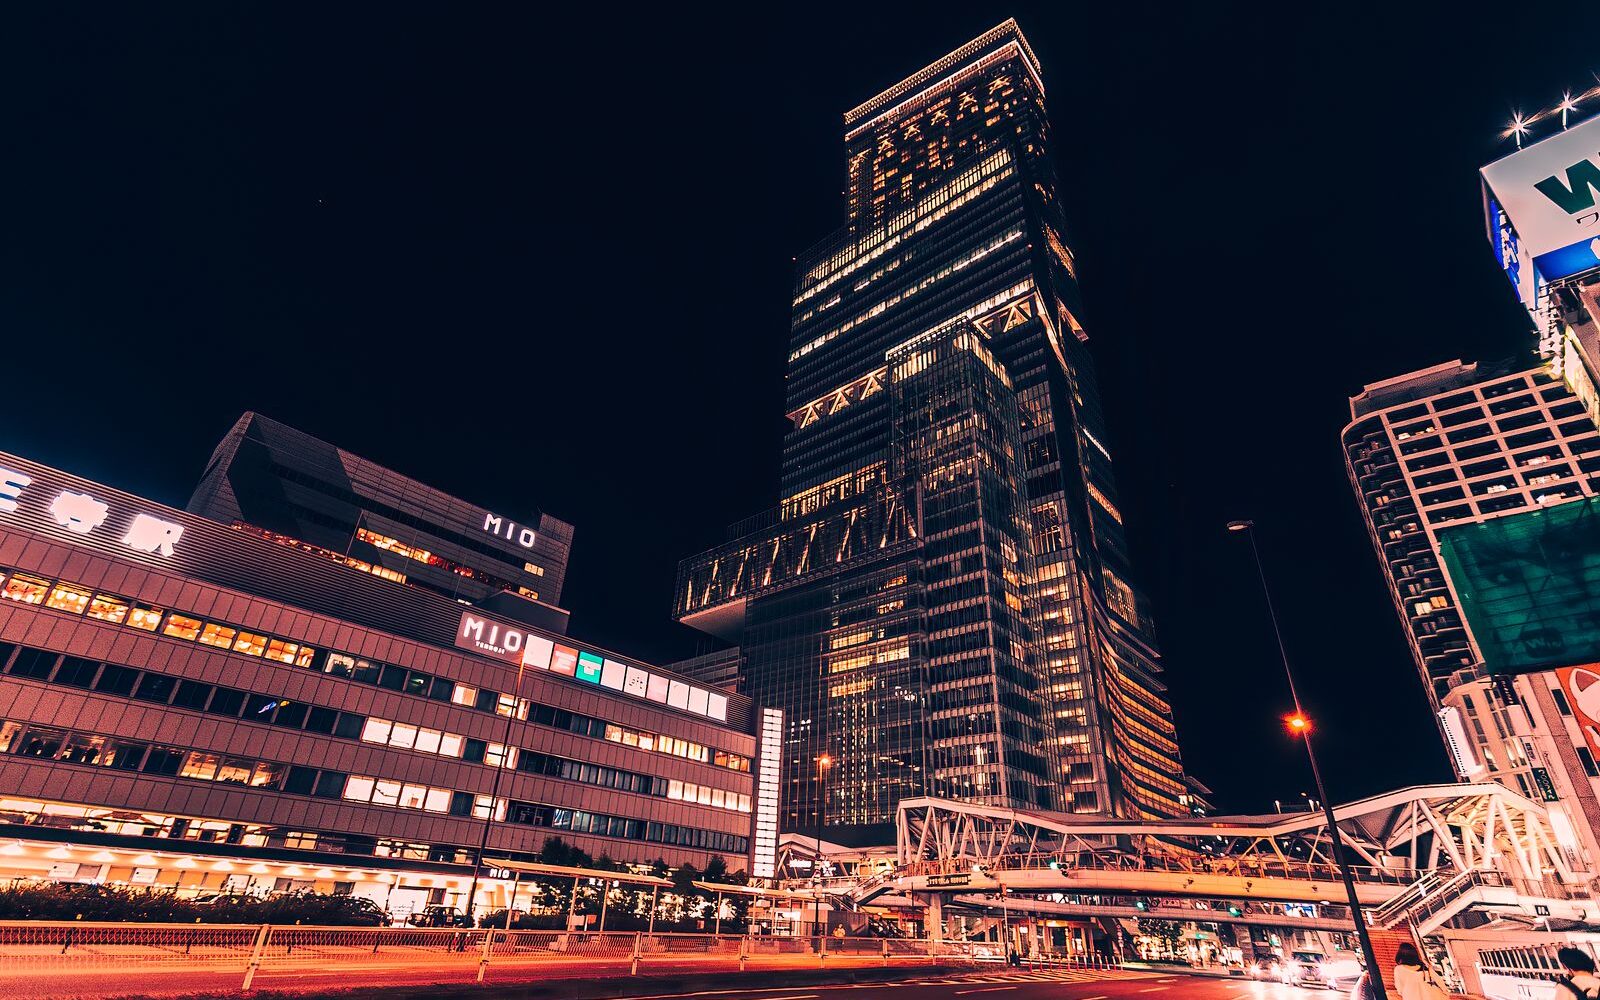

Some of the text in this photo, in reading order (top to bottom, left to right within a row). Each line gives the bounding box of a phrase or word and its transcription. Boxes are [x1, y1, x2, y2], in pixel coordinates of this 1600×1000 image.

[483, 513, 536, 548] MIO
[463, 617, 523, 652] MIO
[489, 868, 511, 879] MIO
